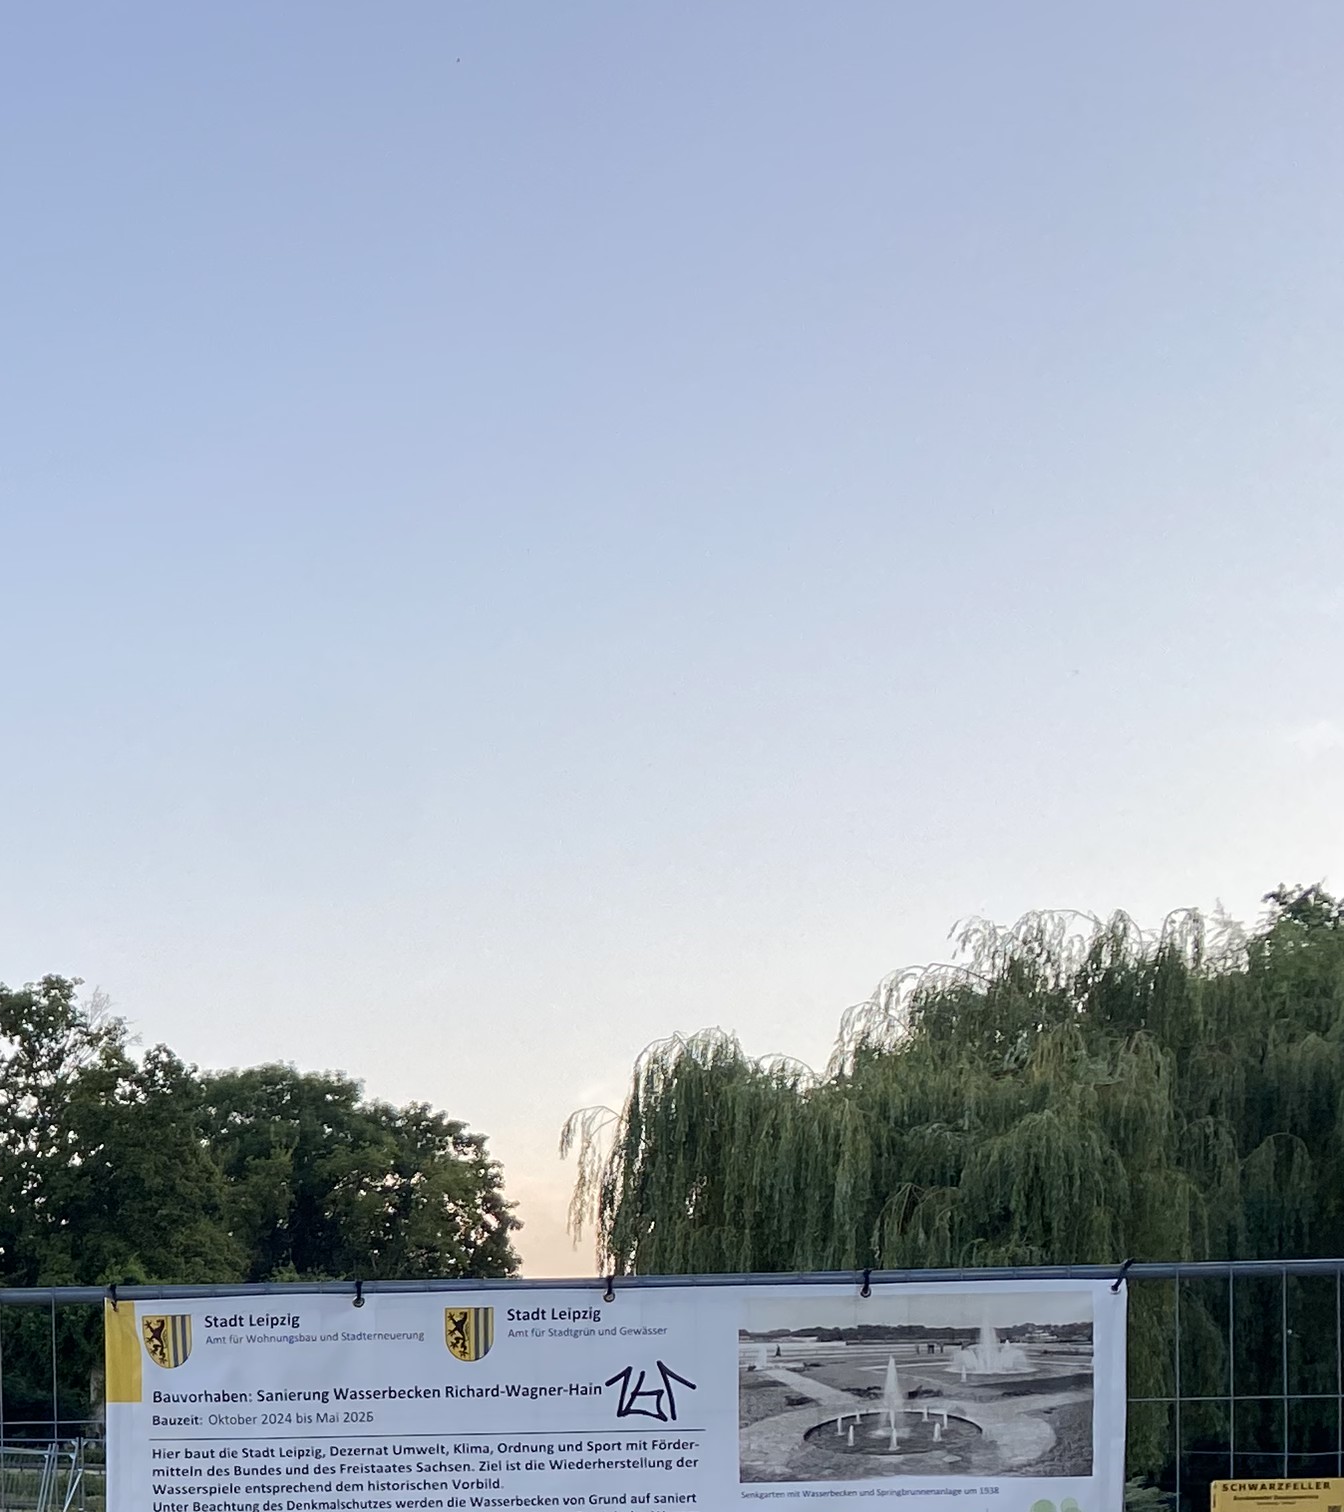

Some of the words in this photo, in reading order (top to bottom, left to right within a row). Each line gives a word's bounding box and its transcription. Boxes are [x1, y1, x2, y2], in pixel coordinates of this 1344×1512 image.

[204, 1313, 244, 1328] Stadt
[248, 1312, 300, 1329] Leipzig
[506, 1307, 546, 1321] Stadt
[550, 1306, 601, 1323] Leipzig
[205, 1335, 227, 1344] Amt
[228, 1333, 244, 1344] für
[245, 1332, 317, 1345] Wohnungsbau
[319, 1332, 339, 1342] und
[340, 1330, 425, 1343] Stadterneuerung
[507, 1328, 529, 1337] Amt
[530, 1327, 546, 1337] für
[547, 1327, 596, 1339] Stadtgrün
[597, 1326, 617, 1336] und
[618, 1325, 668, 1336] Gewässer
[152, 1388, 253, 1404] Bauvorhaben:
[256, 1388, 329, 1405] Sanierung
[332, 1384, 441, 1400] Wasserbecken
[444, 1381, 602, 1401] Richard-Wagner-Hain
[151, 1414, 203, 1426] Bauzeit:
[207, 1413, 258, 1425] Oktober
[260, 1412, 292, 1425] 2024
[295, 1412, 313, 1424] bis
[315, 1412, 339, 1423] Mai
[151, 1448, 181, 1459] Hier
[183, 1447, 215, 1459] baut
[218, 1447, 238, 1459] die
[241, 1446, 276, 1458] Stadt
[278, 1446, 326, 1459] Leipzig,
[329, 1444, 388, 1457] Dezernat
[392, 1443, 449, 1457] Umwelt,
[453, 1442, 494, 1455] Klima,
[496, 1441, 554, 1455] Ordnung
[557, 1440, 583, 1452] und
[586, 1440, 622, 1454] Sport
[625, 1439, 648, 1451] mit
[651, 1439, 699, 1450] Förder-
[151, 1465, 202, 1477] mitteln
[206, 1464, 230, 1476] des
[233, 1464, 282, 1476] Bundes
[285, 1463, 309, 1475] und
[312, 1463, 336, 1474] des
[339, 1462, 412, 1474] Freistaates
[415, 1460, 475, 1473] Sachsen.
[478, 1460, 502, 1472] Ziel
[505, 1460, 521, 1471] ist
[524, 1459, 545, 1470] die
[548, 1457, 672, 1472] Wiederherstellung
[675, 1456, 699, 1467] der
[151, 1482, 241, 1497] Wasserspiele
[244, 1481, 332, 1496] entsprechend
[335, 1480, 364, 1492] dem
[367, 1478, 448, 1491] historischen
[451, 1478, 504, 1490] Vorbild.
[740, 1490, 786, 1500] Senkgarten
[801, 1489, 858, 1498] Wasserbecken
[875, 1487, 962, 1497] Springbrunnenanlage
[1222, 1481, 1331, 1492] SCHWARZFELLER
[152, 1501, 189, 1512] Unter
[262, 1499, 283, 1511] des
[286, 1497, 392, 1511] Denkmalschutzes
[394, 1496, 443, 1509] werden
[446, 1496, 466, 1508] die
[469, 1494, 559, 1507] Wasserbecken
[562, 1496, 585, 1505] von
[588, 1493, 627, 1505] Grund
[630, 1492, 651, 1504] auf
[653, 1493, 697, 1504] saniert
